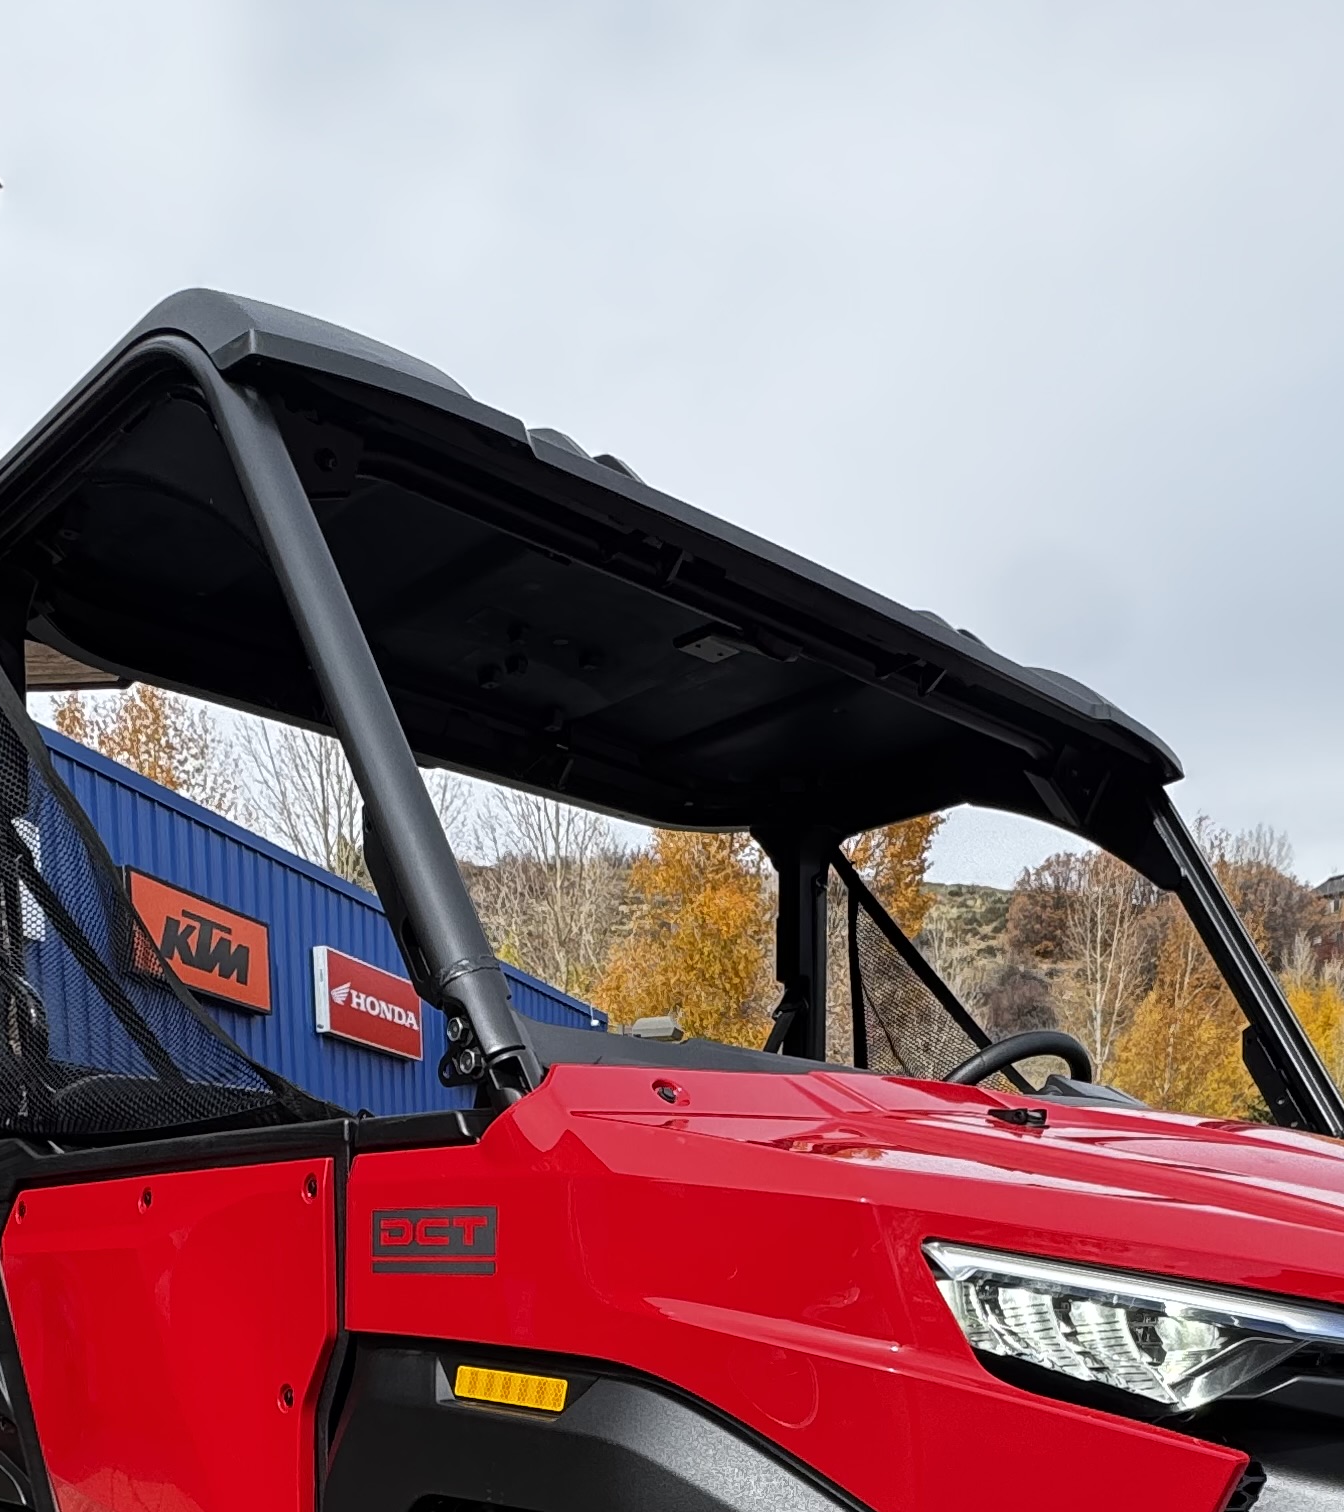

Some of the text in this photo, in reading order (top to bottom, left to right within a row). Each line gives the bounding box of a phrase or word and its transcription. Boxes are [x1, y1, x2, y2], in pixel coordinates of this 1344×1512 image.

[160, 909, 250, 985] KTM
[350, 989, 420, 1031] HONDA
[380, 1215, 488, 1246] DCT
